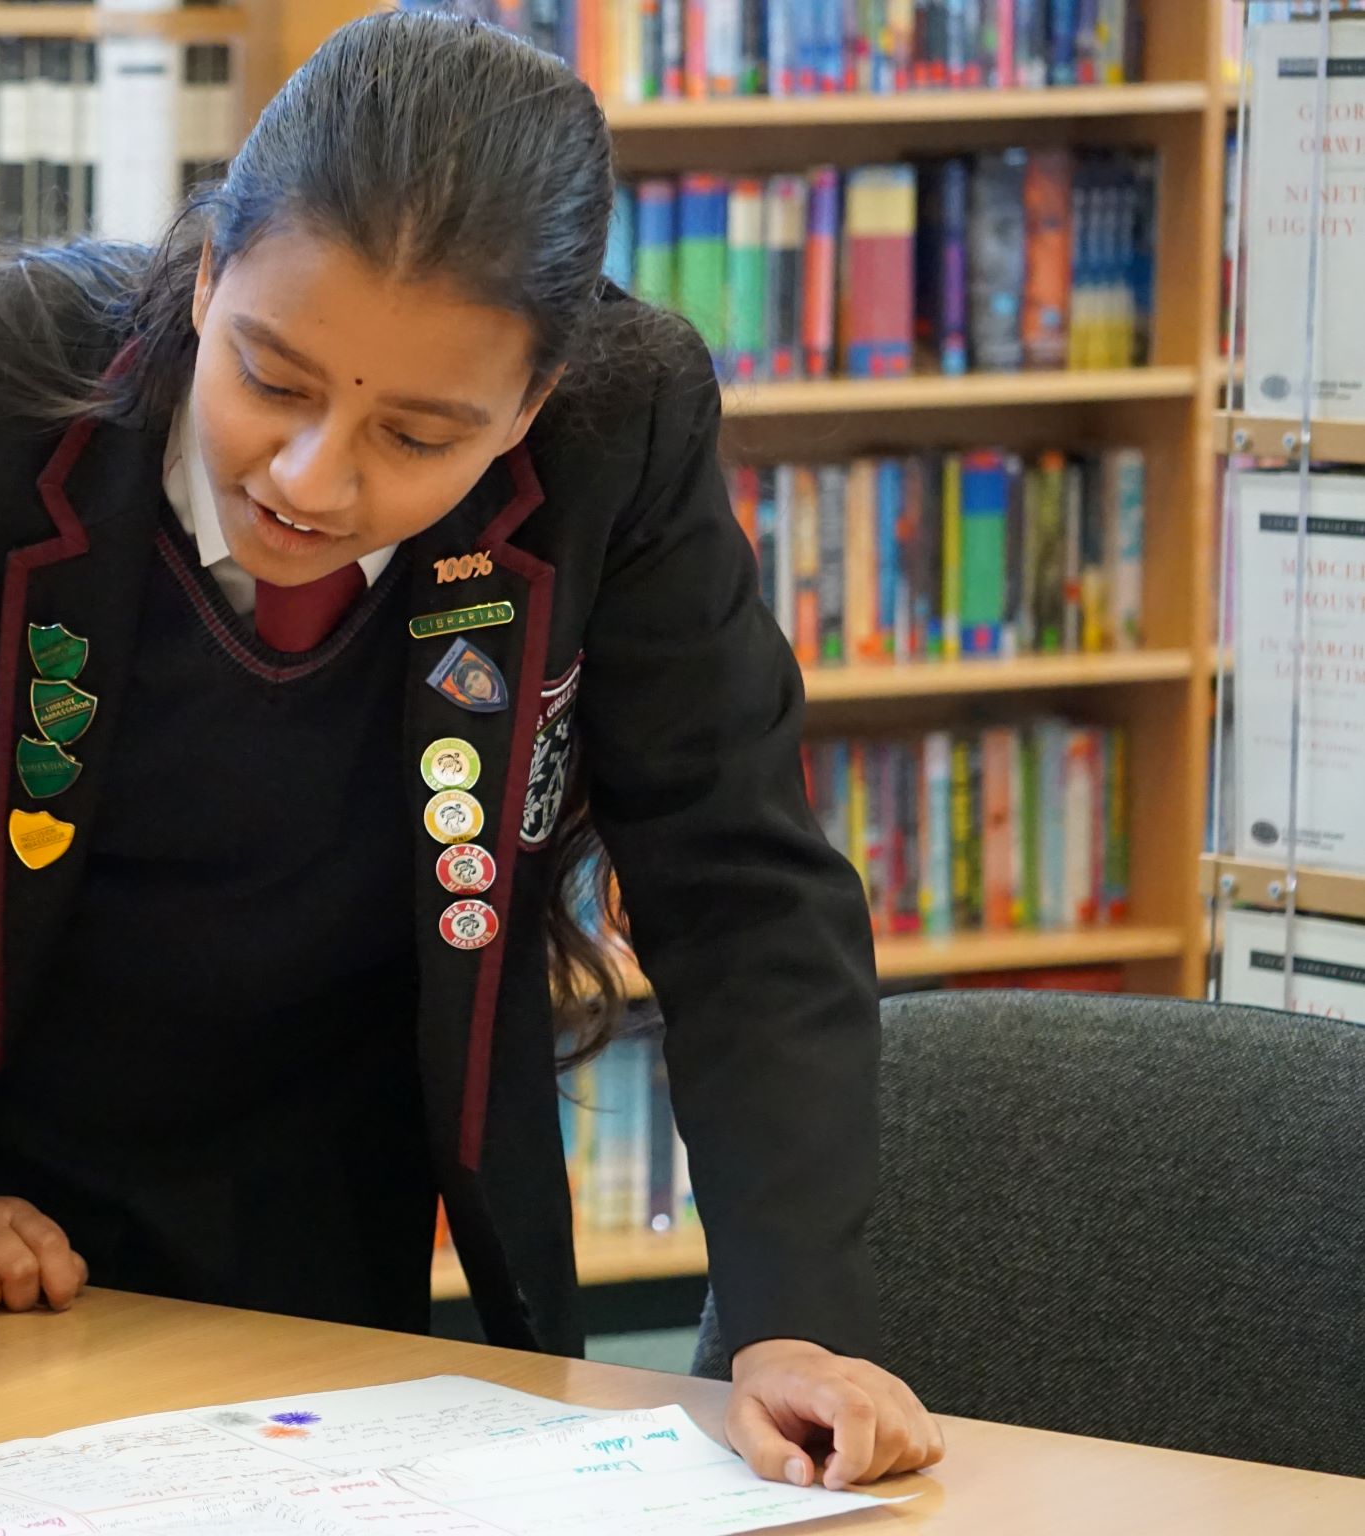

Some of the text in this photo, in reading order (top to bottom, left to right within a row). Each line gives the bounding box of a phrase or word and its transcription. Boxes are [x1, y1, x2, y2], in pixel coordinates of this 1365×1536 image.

[433, 550, 493, 584] 100%
[419, 607, 506, 632] LIBRARIAN
[442, 847, 486, 861] WE ARE
[444, 903, 487, 919] WE ARE
[451, 931, 493, 948] HARPER
